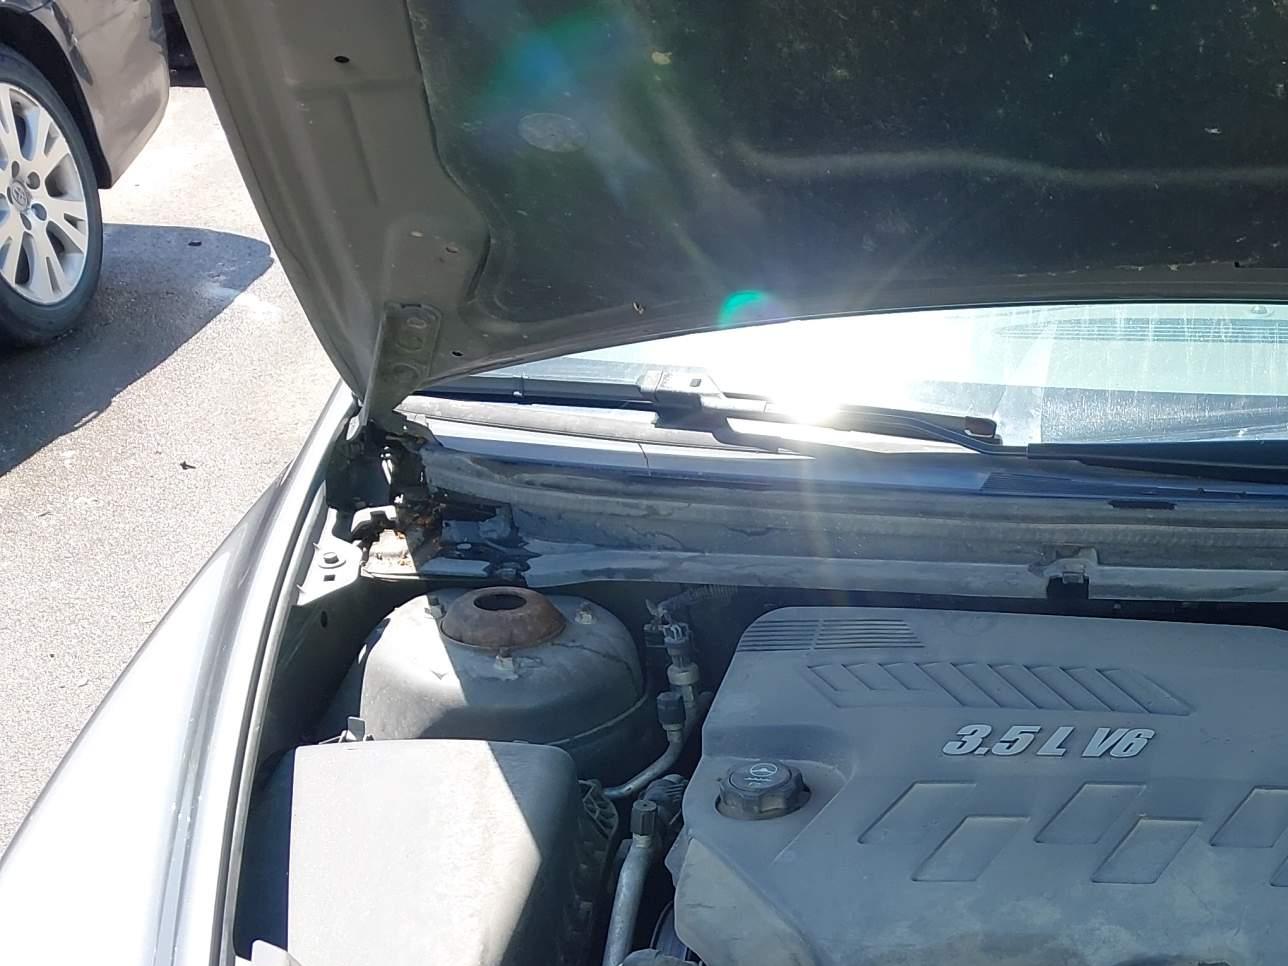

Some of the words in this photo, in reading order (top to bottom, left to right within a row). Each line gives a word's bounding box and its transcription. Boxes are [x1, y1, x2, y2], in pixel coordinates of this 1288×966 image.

[942, 724, 1042, 756] 3.5
[1036, 726, 1075, 756] L
[1081, 727, 1155, 758] V6
